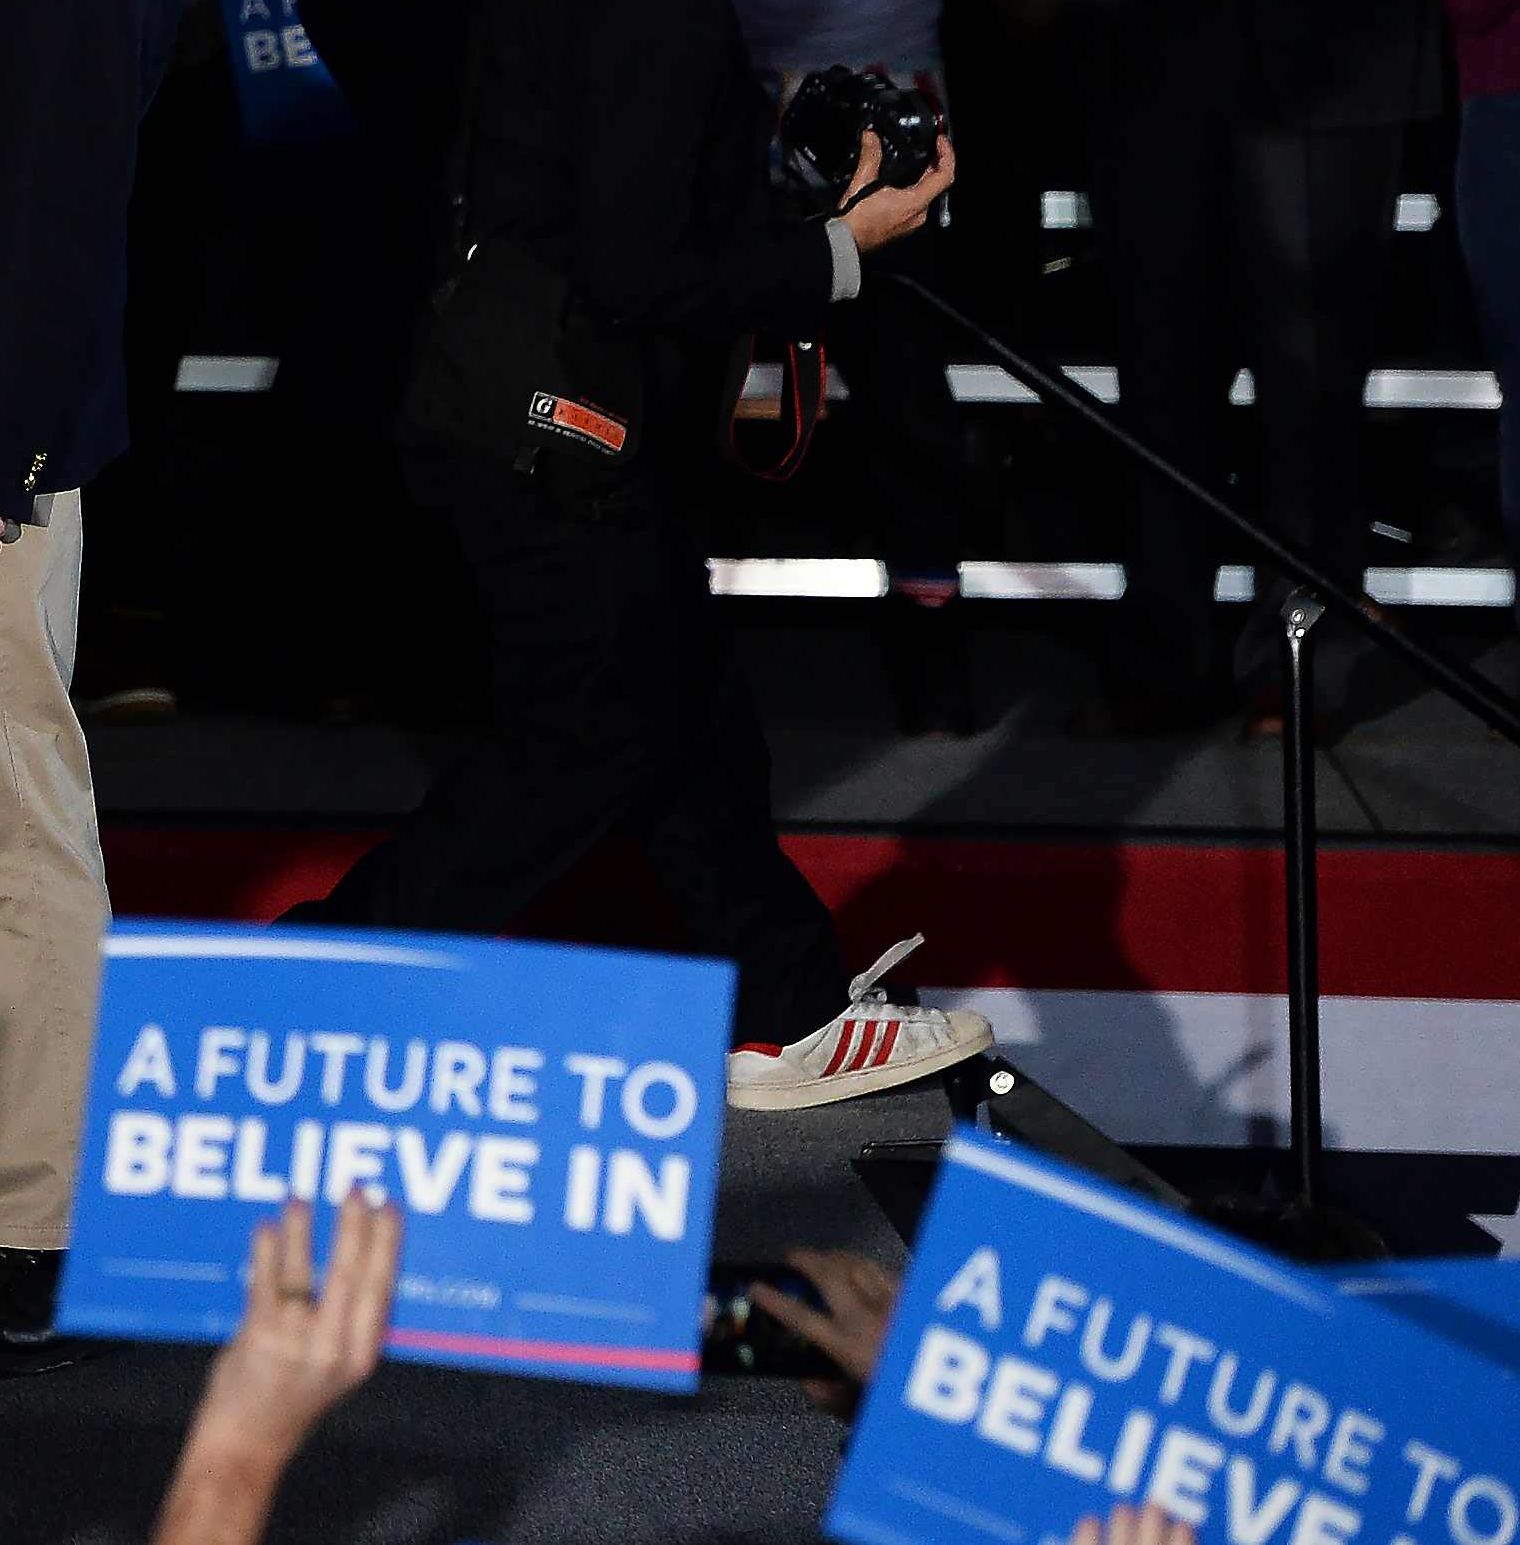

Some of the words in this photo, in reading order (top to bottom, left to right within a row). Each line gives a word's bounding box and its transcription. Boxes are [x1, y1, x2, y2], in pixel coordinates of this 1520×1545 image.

[116, 1022, 179, 1101] A
[193, 1023, 545, 1127] FUTURE
[562, 1052, 700, 1141] TO
[101, 1107, 542, 1227] BELIEVE
[561, 1144, 692, 1243] IN
[934, 1245, 1005, 1331] A
[1021, 1271, 1388, 1494] FUTURE
[1397, 1434, 1520, 1545] TO
